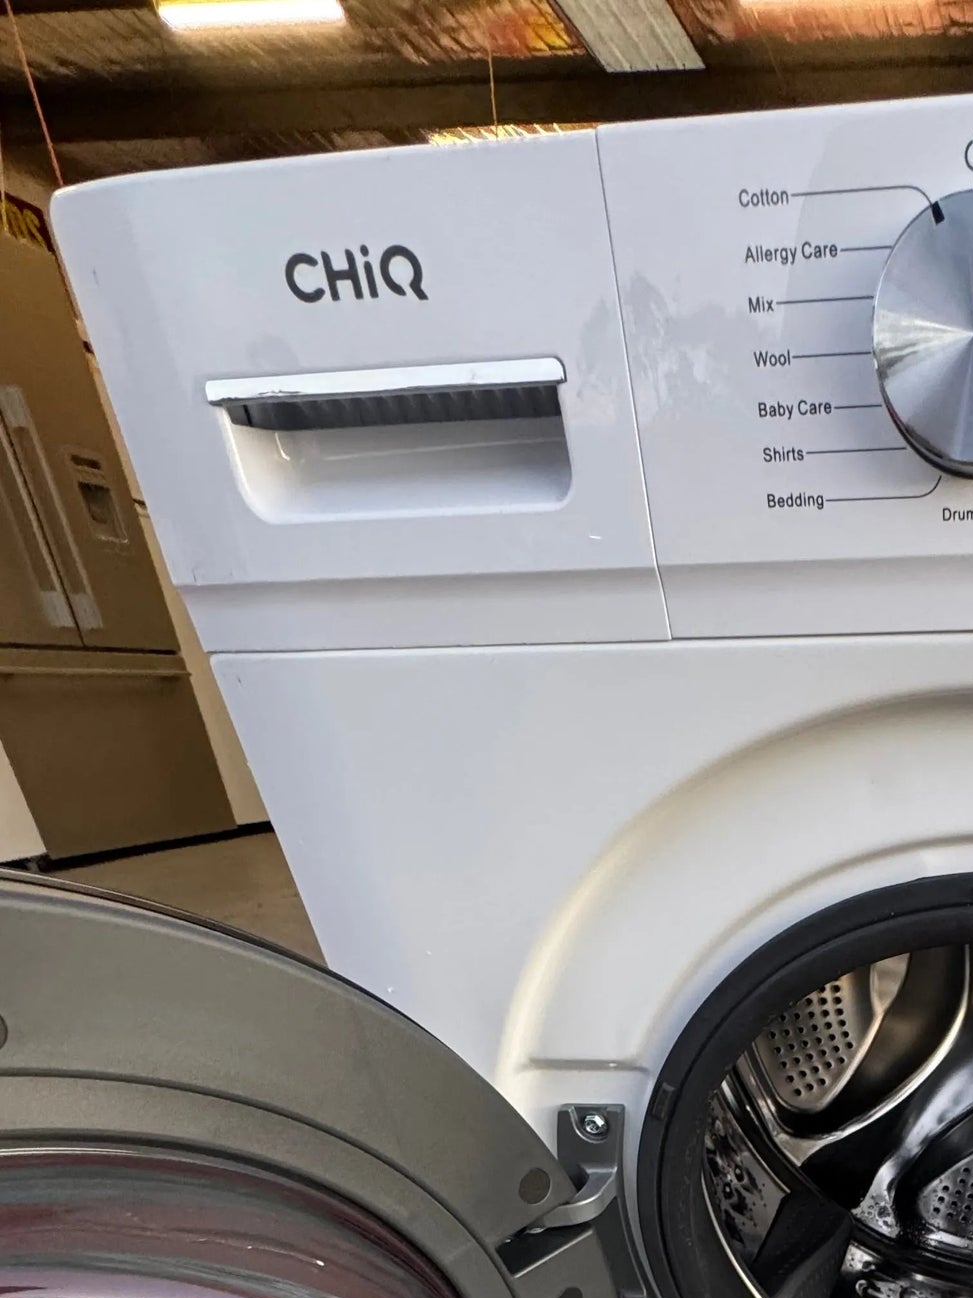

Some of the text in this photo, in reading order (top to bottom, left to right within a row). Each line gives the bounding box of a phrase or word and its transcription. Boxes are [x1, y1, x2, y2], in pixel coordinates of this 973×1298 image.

[738, 188, 790, 208] Cotton
[744, 242, 838, 265] Allergy Care
[284, 243, 430, 303] CHiQ
[748, 296, 775, 312] Mix
[753, 349, 791, 367] Wool
[758, 399, 833, 420] Baby Care
[762, 446, 805, 463] Shirts
[766, 492, 825, 511] Bedding
